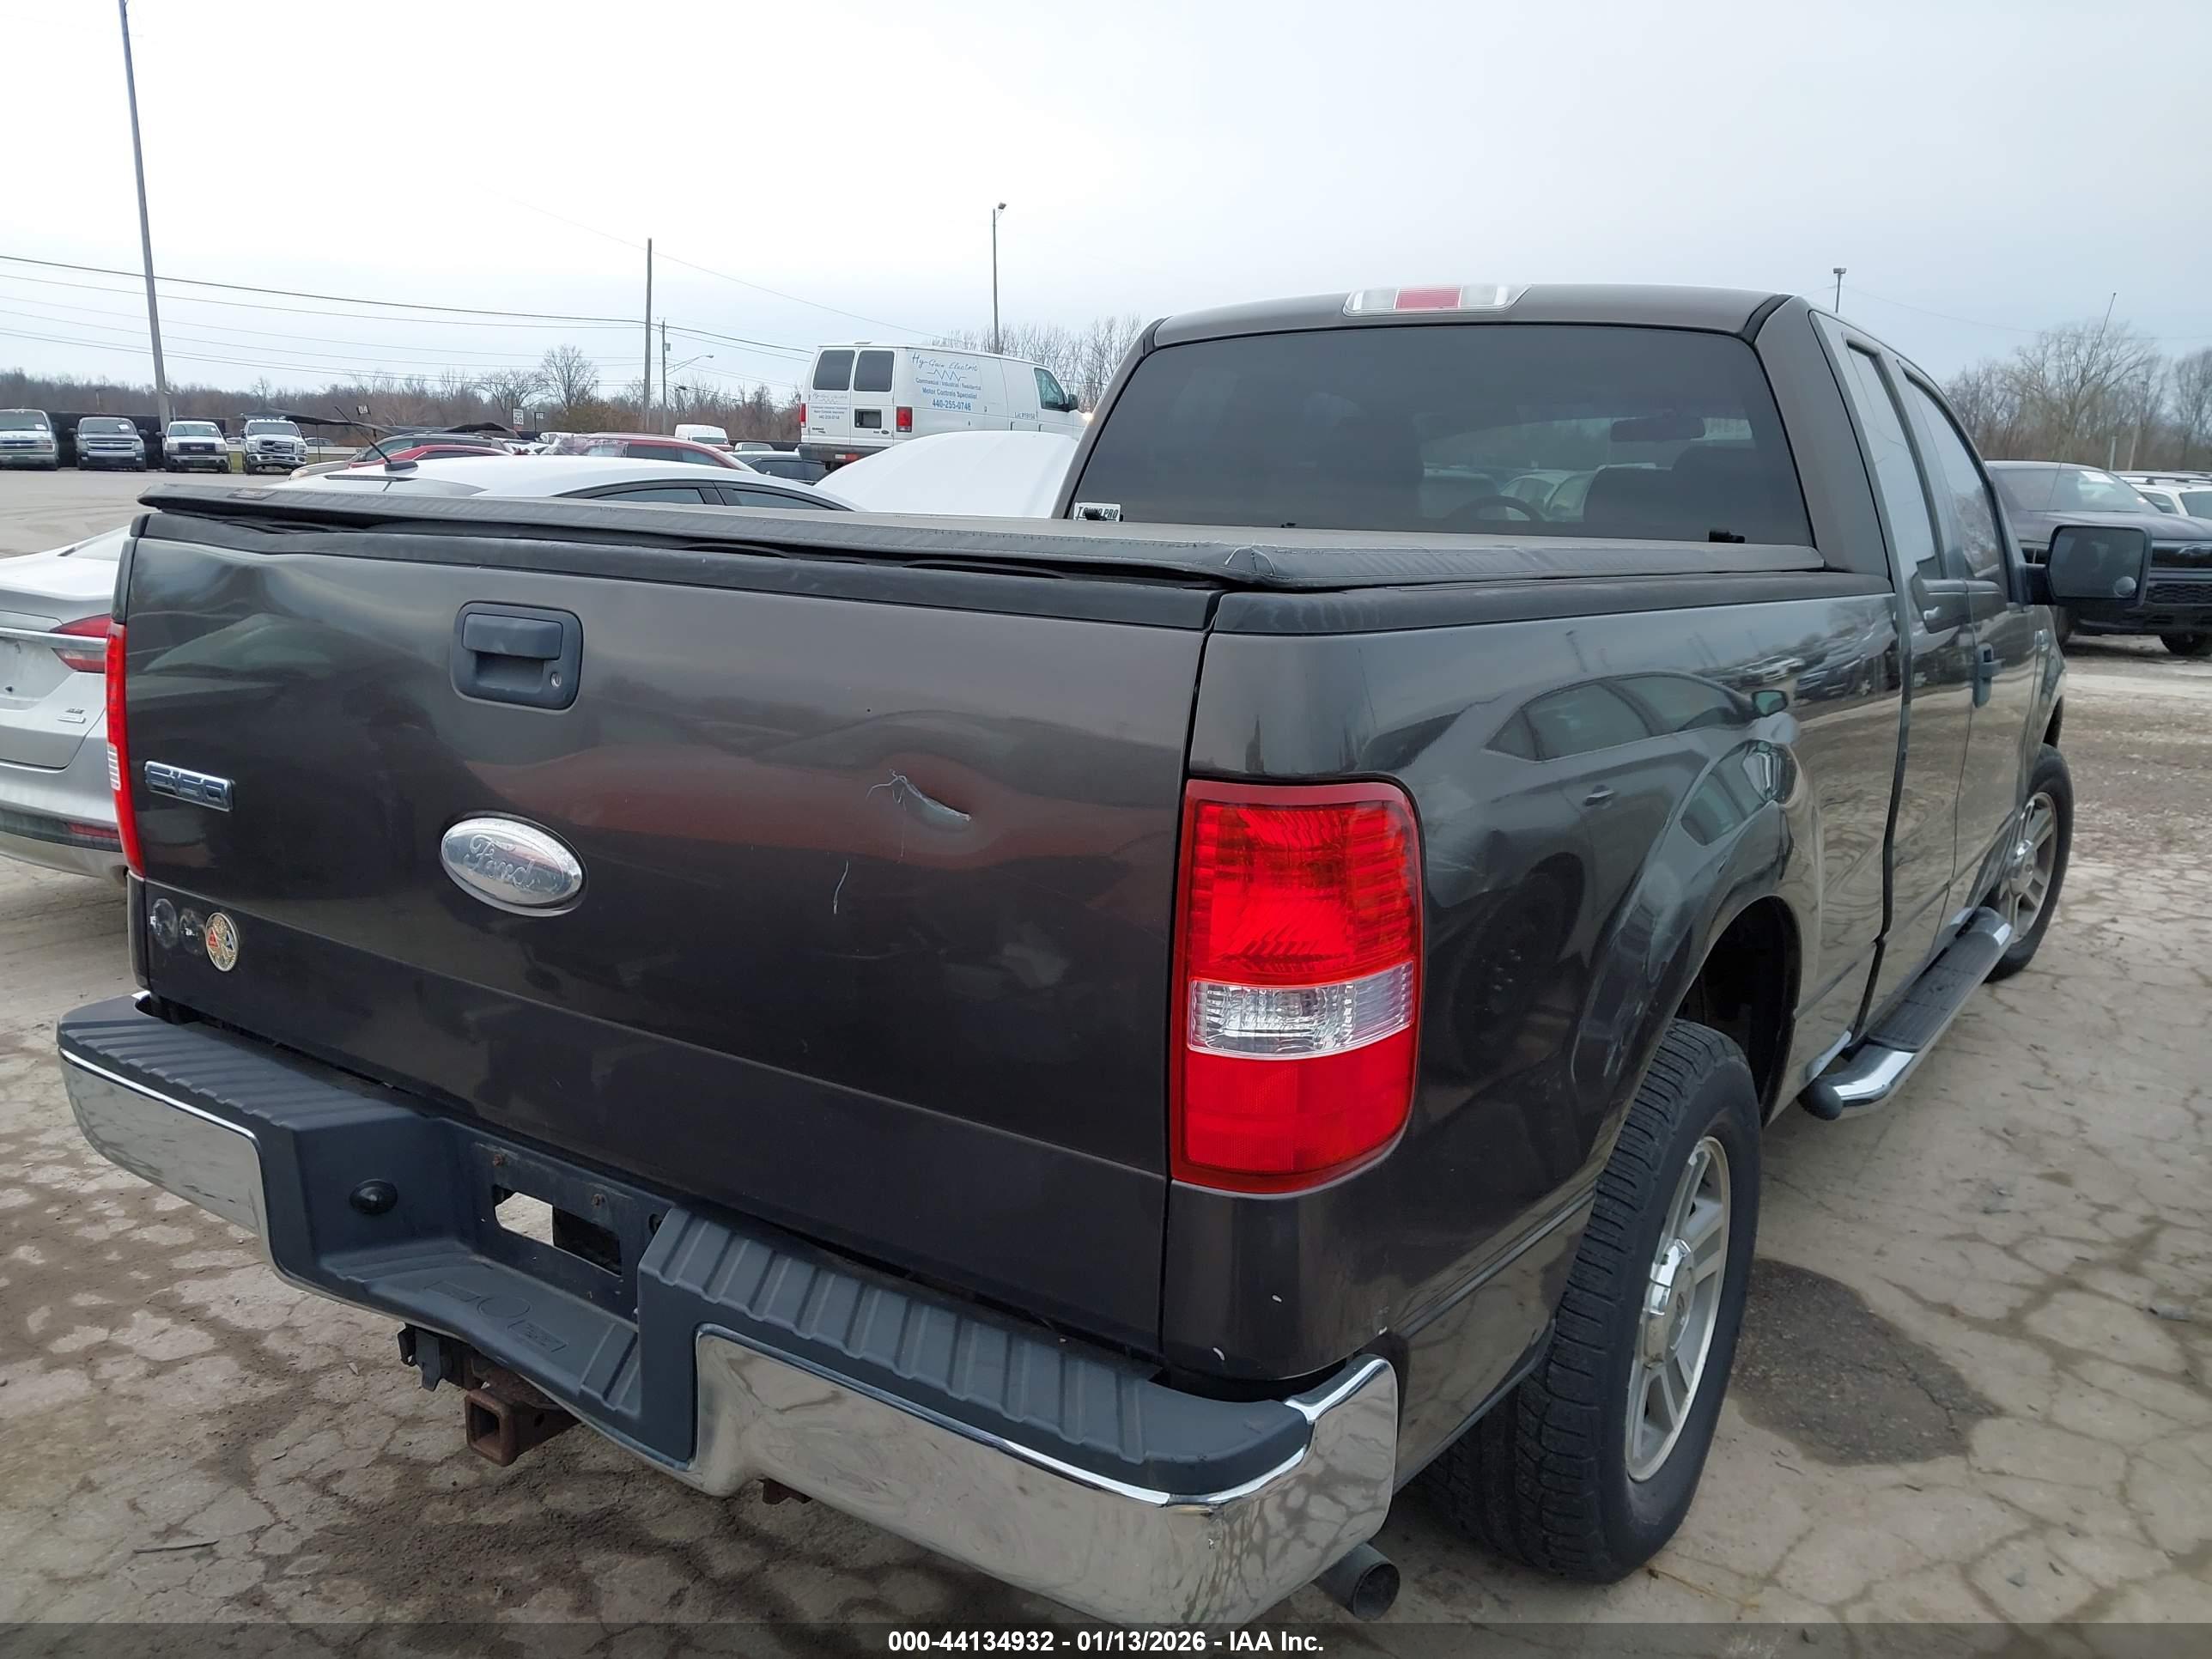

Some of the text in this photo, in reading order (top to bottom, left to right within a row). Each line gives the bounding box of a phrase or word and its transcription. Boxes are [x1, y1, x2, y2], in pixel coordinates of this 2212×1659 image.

[932, 398, 972, 411] 440-255-0748
[1103, 508, 1119, 520] PRO
[464, 834, 537, 890] Ford
